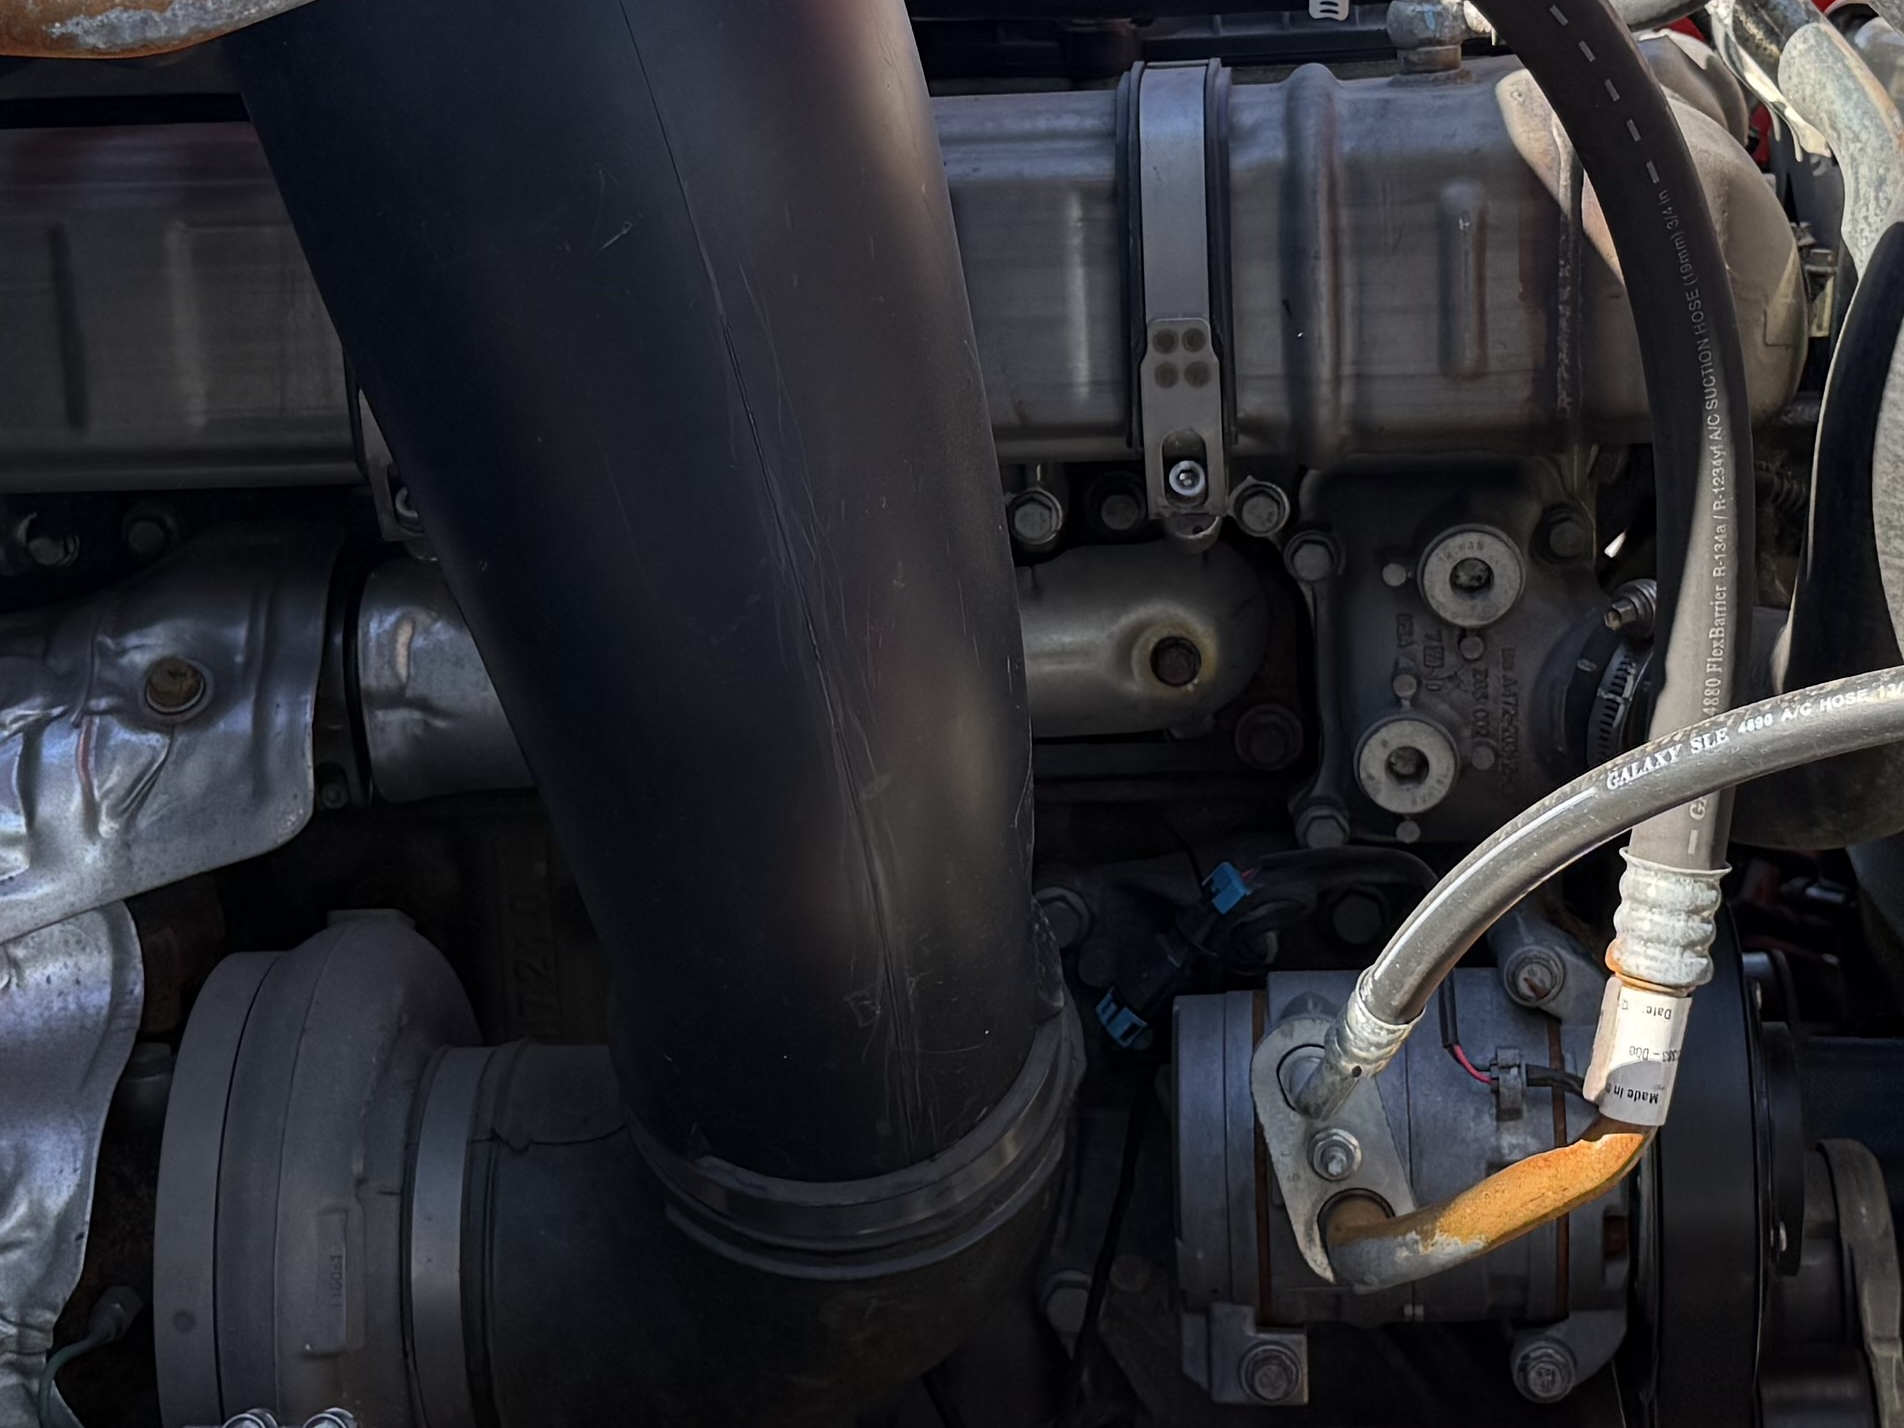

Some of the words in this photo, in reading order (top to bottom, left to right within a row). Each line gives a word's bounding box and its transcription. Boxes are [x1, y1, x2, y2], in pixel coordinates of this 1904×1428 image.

[1657, 189, 1673, 206] in
[1662, 206, 1681, 230] 3/4
[1669, 231, 1699, 287] (19mm)
[1685, 288, 1708, 334] HOSE
[1695, 338, 1719, 410] SUCTION
[1706, 414, 1723, 441] A/C
[1710, 444, 1729, 511] R-1234yf
[1712, 524, 1727, 578] R-134a
[1706, 584, 1728, 673] FlexBarrier
[1702, 678, 1722, 715] 4880
[1607, 744, 1682, 790] GALAXY
[1690, 727, 1730, 755] SLE
[1781, 703, 1812, 722] A/C
[1819, 689, 1869, 711] HOSE
[1627, 1089, 1659, 1104] Made
